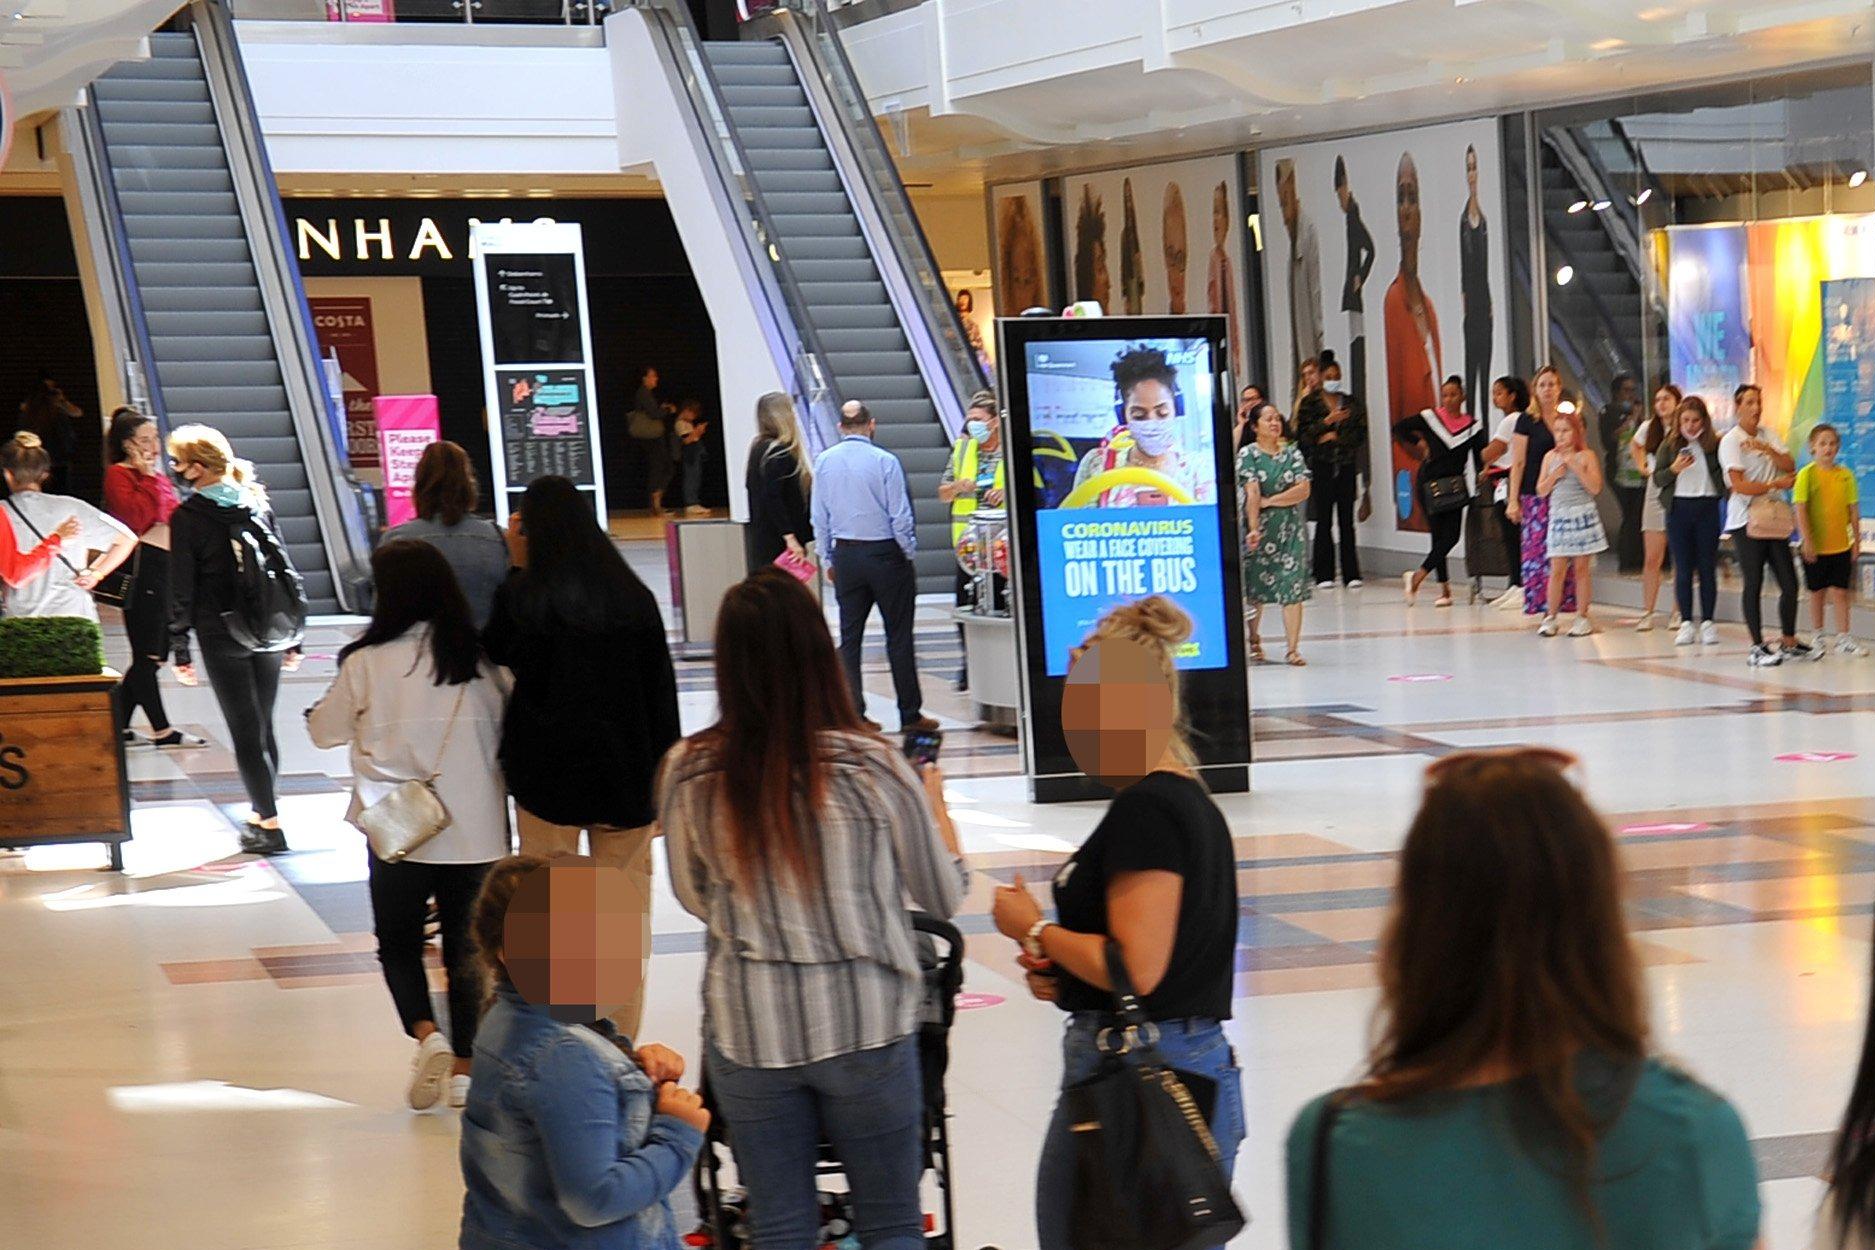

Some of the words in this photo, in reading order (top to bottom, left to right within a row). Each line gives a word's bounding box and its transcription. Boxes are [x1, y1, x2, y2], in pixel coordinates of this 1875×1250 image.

[314, 315, 365, 328] COSTA
[1165, 350, 1196, 366] NHS
[388, 434, 431, 444] Please
[1062, 520, 1194, 539] CORONAVIRUS
[1063, 539, 1097, 559] WEAR
[1099, 540, 1108, 557] A
[1109, 538, 1136, 557] FACE
[1137, 536, 1194, 556] COVERING
[1065, 561, 1098, 596] ON
[1102, 559, 1147, 594] THE
[1152, 557, 1197, 593] BUS
